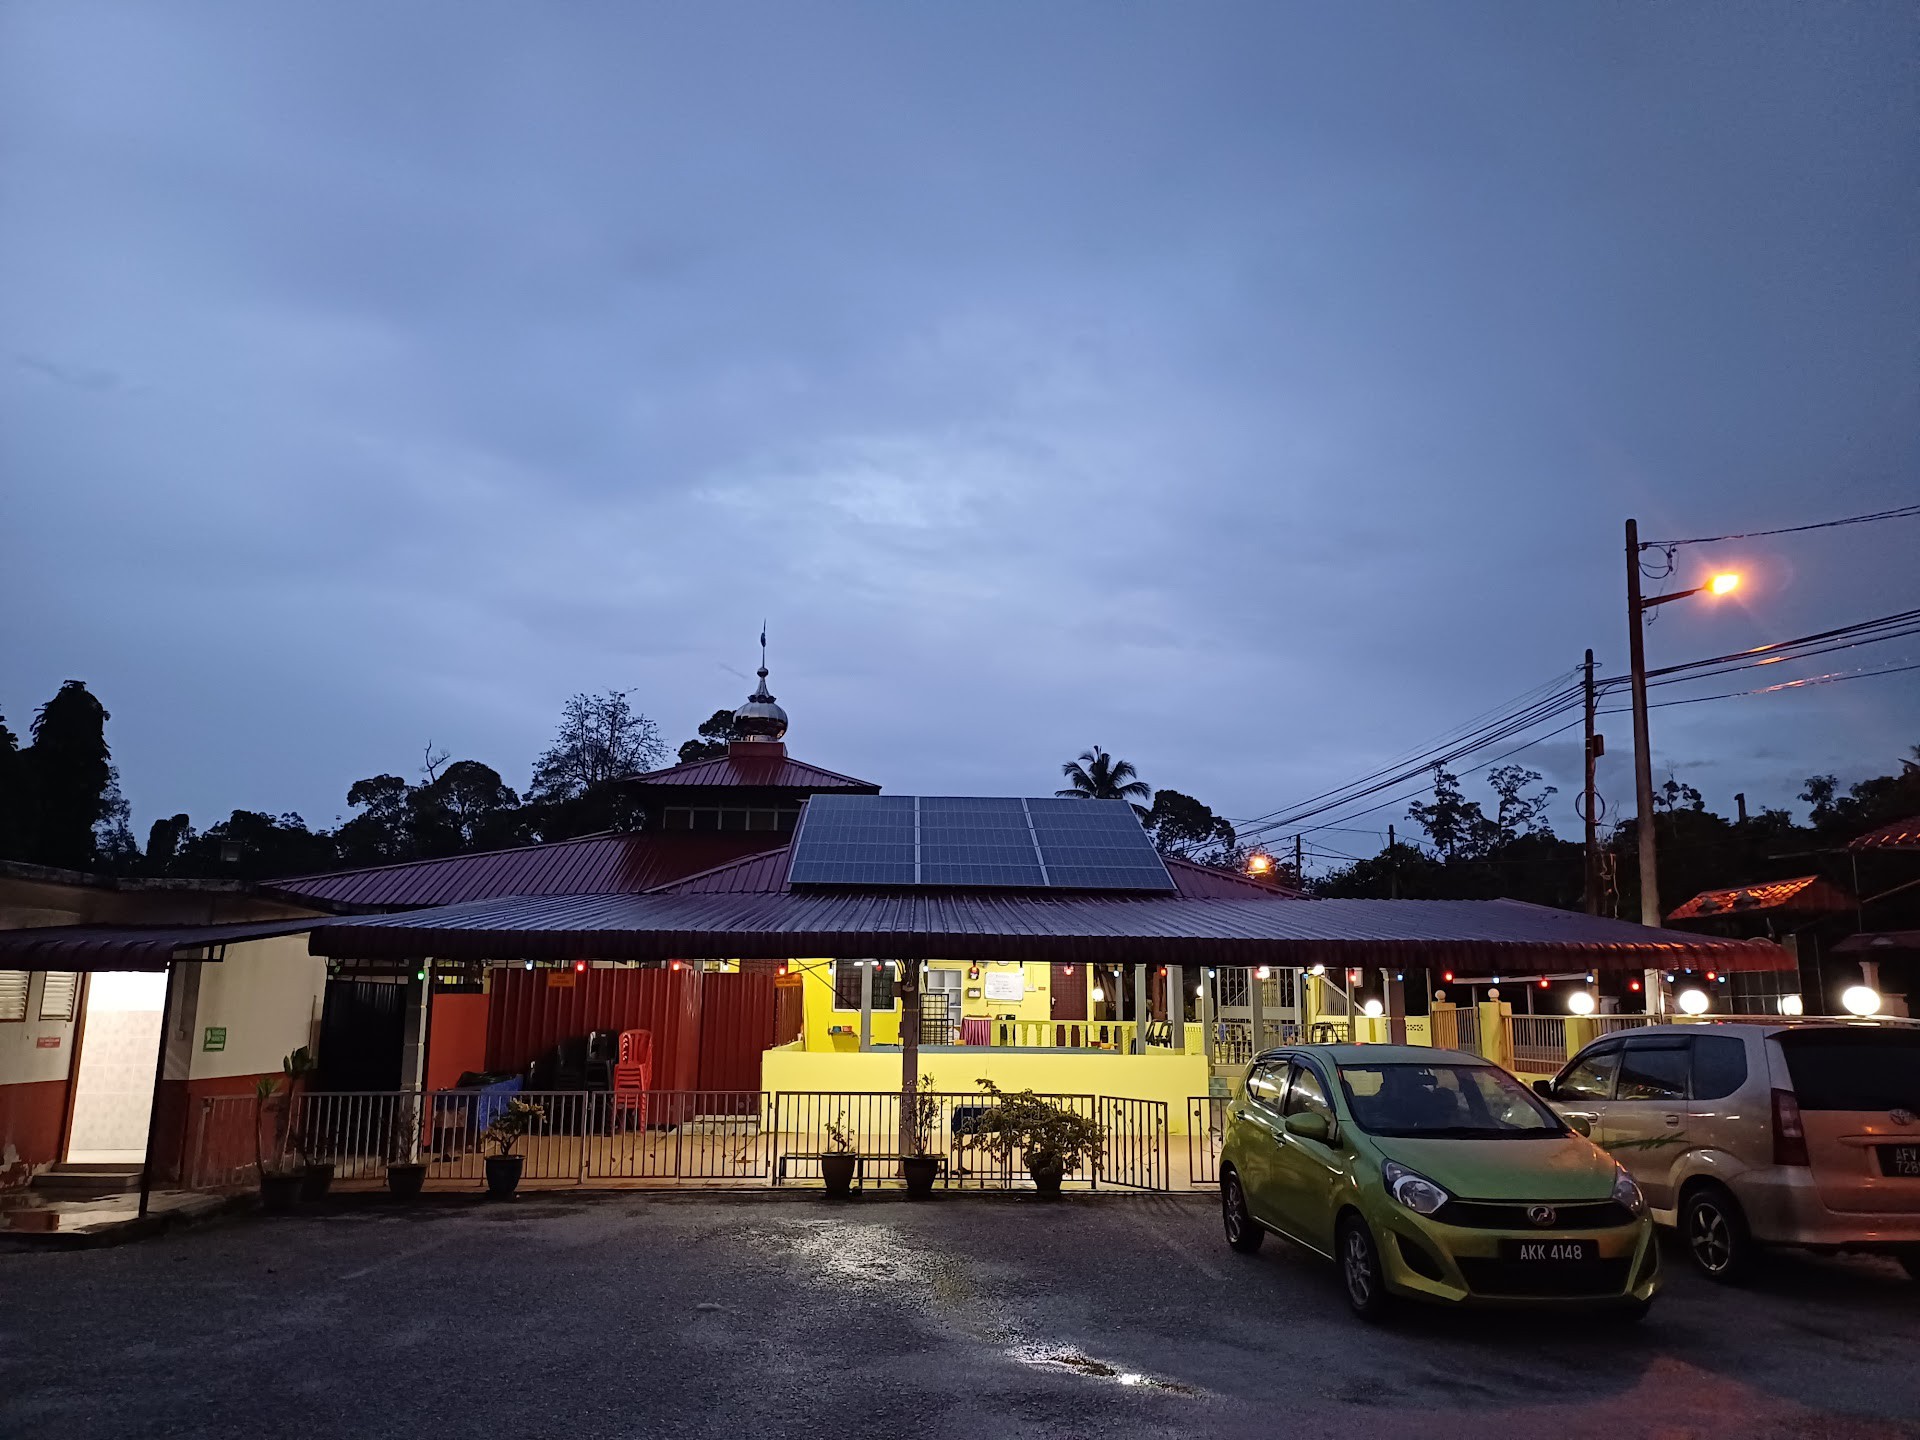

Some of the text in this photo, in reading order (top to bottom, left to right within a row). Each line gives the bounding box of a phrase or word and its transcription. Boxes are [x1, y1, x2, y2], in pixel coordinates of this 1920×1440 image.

[1896, 1148, 1917, 1161] AFV
[1896, 1161, 1920, 1174] 728
[1520, 1245, 1583, 1260] AKK 4148
